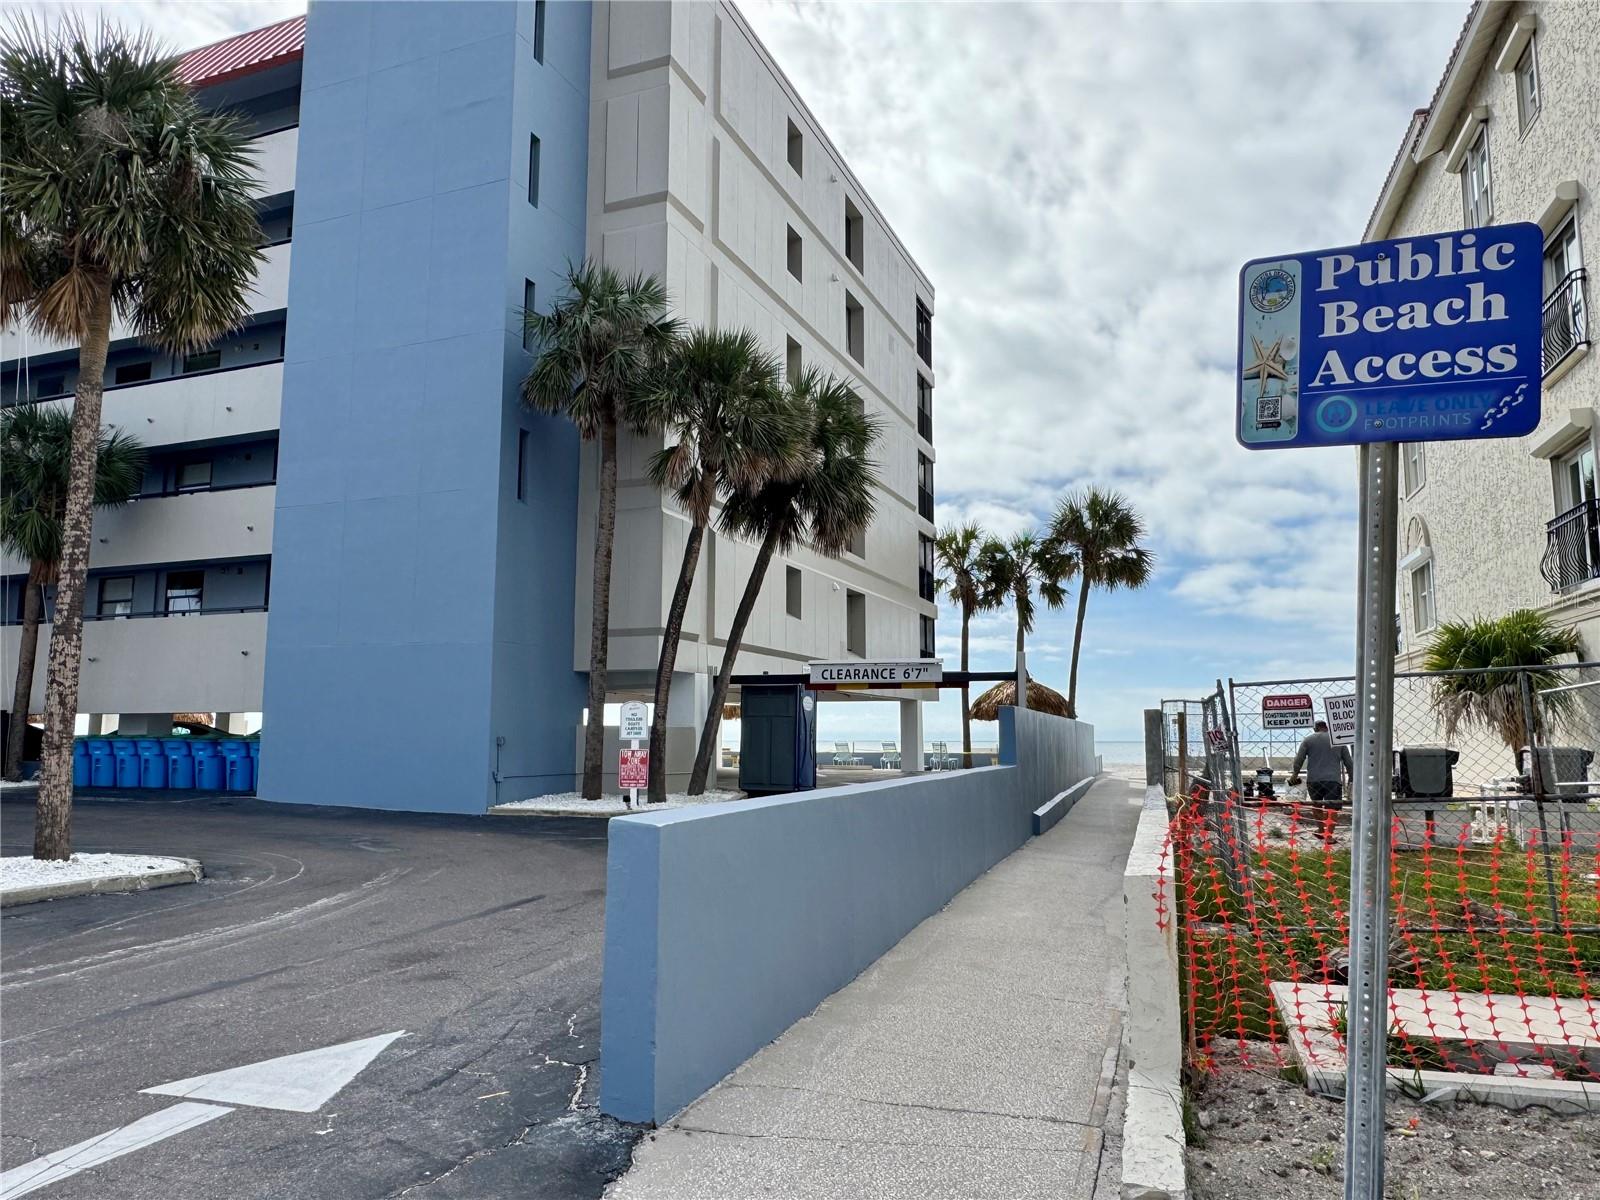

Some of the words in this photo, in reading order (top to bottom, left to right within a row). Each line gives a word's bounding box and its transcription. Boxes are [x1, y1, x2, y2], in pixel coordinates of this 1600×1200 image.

[1315, 233, 1515, 292] Public
[1318, 282, 1509, 338] Beach
[1308, 343, 1517, 387] Access
[1365, 397, 1429, 416] LEAVE
[1434, 392, 1496, 412] ONLY
[821, 668, 896, 680] CLEARANCE
[903, 667, 928, 680] 6'7"
[1266, 698, 1308, 707] DANGER
[1329, 701, 1341, 710] DO
[1265, 711, 1299, 719] CONSTRUCTION
[1292, 718, 1310, 726] OUT
[622, 750, 632, 758] TOW
[634, 750, 647, 758] AWAY
[627, 757, 640, 765] ZONE
